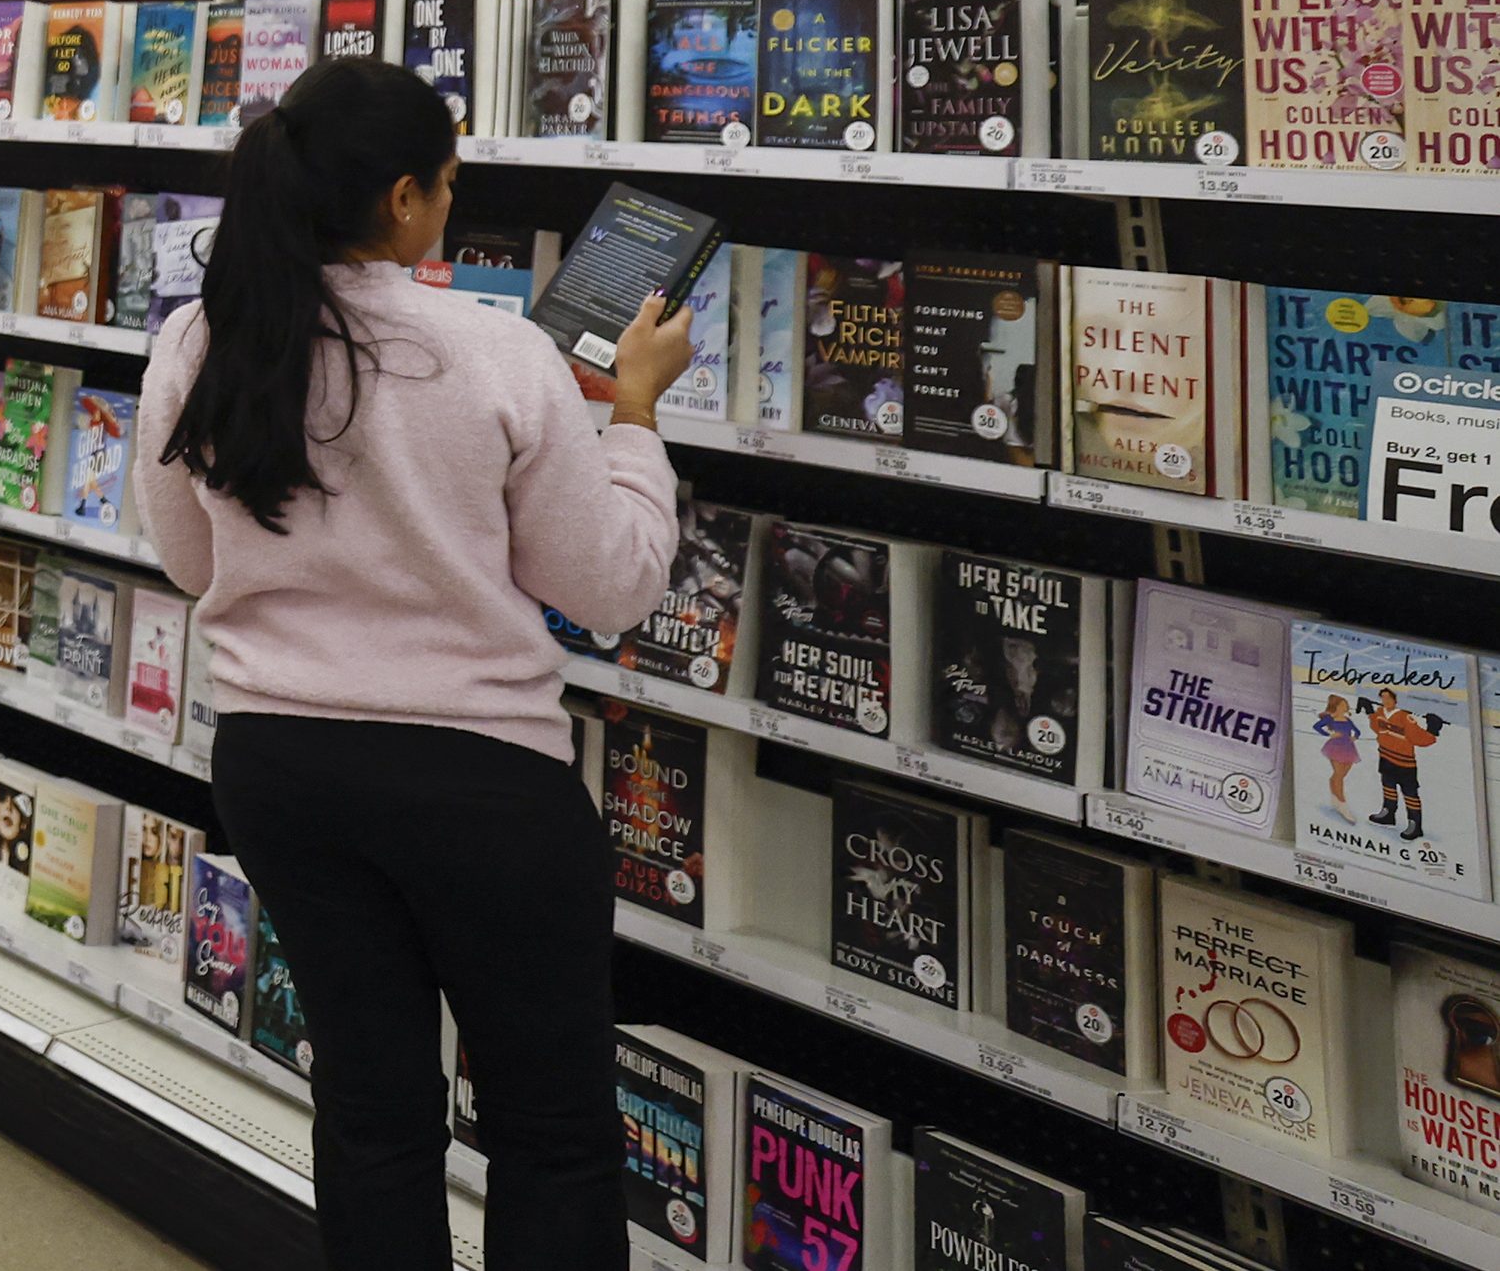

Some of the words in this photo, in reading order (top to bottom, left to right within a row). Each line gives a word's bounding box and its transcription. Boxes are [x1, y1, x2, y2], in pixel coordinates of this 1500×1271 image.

[414, 0, 444, 27] ONE
[814, 13, 825, 24] A
[930, 5, 994, 32] LISA
[51, 34, 82, 46] BEFORE
[247, 31, 305, 46] LOCAL
[324, 31, 374, 56] LOCKED
[430, 28, 446, 48] BY
[679, 35, 722, 51] ALL
[767, 37, 872, 53] FLICKER
[1253, 16, 1356, 52] WITH
[2, 43, 14, 55] IT
[61, 49, 75, 58] LET
[907, 35, 1018, 67] JEWELL
[58, 62, 70, 72] GO
[246, 57, 304, 70] WOMAN
[433, 49, 465, 77] ONE
[802, 68, 817, 77] IN
[824, 68, 852, 77] THE
[1095, 39, 1244, 88] Verity
[1415, 56, 1473, 94] US
[1256, 58, 1307, 94] US
[652, 85, 749, 98] DANGEROUS
[657, 109, 740, 124] THINGS
[763, 92, 871, 118] DARK
[931, 97, 1012, 116] FAMILY
[1286, 106, 1382, 125] COLLEEN
[729, 129, 741, 139] 20
[853, 130, 865, 139] 20
[987, 126, 1003, 140] 20
[1116, 118, 1216, 136] COLLEEN
[1203, 144, 1223, 156] 20
[416, 265, 453, 283] deals
[830, 299, 903, 325] FILTHY
[914, 305, 985, 320] FORGIVING
[1118, 299, 1156, 317] THE
[1278, 295, 1312, 329] IT
[839, 321, 902, 347] RICH
[914, 325, 947, 337] WHAT
[1084, 325, 1191, 358] SILENT
[1462, 311, 1497, 348] IT
[914, 344, 938, 356] YOU
[1274, 333, 1418, 377] STARTS
[697, 377, 709, 388] 20
[913, 364, 949, 377] CAN'T
[1077, 364, 1200, 400] PATIENT
[913, 384, 960, 399] FORGET
[882, 411, 899, 426] 20
[979, 414, 996, 428] 30
[1390, 405, 1450, 427] Books,
[78, 423, 104, 458] GIRL
[1113, 437, 1158, 454] ALEX
[1162, 452, 1180, 466] 20
[1386, 441, 1420, 458] Buy
[1425, 446, 1440, 461] 2,
[1446, 450, 1477, 465] get
[1484, 454, 1492, 466] 1
[72, 445, 122, 489] ABROAD
[1233, 513, 1276, 531] 14.39
[958, 562, 1001, 593] HER
[1006, 572, 1069, 608] SOUL
[990, 594, 1048, 634] TAKE
[654, 615, 720, 658] WITCH
[693, 663, 709, 678] 20
[782, 640, 821, 669] HER
[825, 650, 879, 686] SOUL
[1301, 650, 1456, 690] Icebreaker
[792, 670, 885, 709] REVENGE
[1169, 669, 1213, 700] THE
[1143, 687, 1277, 750] STRIKER
[1037, 731, 1054, 744] 20
[952, 732, 1004, 751] HARLEY
[1008, 748, 1063, 769] LAROUX
[609, 748, 689, 790] BOUND
[1142, 764, 1183, 788] ANA
[1226, 784, 1248, 804] 20
[604, 792, 692, 838] SHADOW
[1105, 810, 1144, 832] 14.40
[609, 818, 685, 862] PRINCE
[1310, 824, 1390, 855] HANNAH
[844, 832, 945, 884] CROSS
[1418, 849, 1438, 863] 20
[1295, 864, 1338, 884] 14.39
[671, 880, 687, 894] 20
[846, 891, 946, 945] HEART
[1029, 910, 1101, 944] TOUCH
[1211, 917, 1254, 943] THE
[1176, 924, 1302, 979] PERFECT
[836, 948, 882, 977] ROXY
[887, 966, 957, 1004] SLOANE
[1015, 943, 1118, 990] DARKNESS
[1174, 946, 1307, 1006] MARRIAGE
[1082, 1014, 1101, 1031] 20
[615, 1043, 658, 1083] PENELOPE
[1403, 1067, 1429, 1085] THE
[1178, 1074, 1254, 1113] JENEVA
[1271, 1087, 1294, 1110] 20
[753, 1093, 806, 1143] PENELOPE
[808, 1122, 861, 1163] DOUGLAS
[1136, 1114, 1178, 1139] 12.79
[752, 1125, 860, 1231] PUNK
[1411, 1154, 1469, 1189] FREIDA
[1330, 1189, 1376, 1216] 13.59
[803, 1214, 859, 1271] 57
